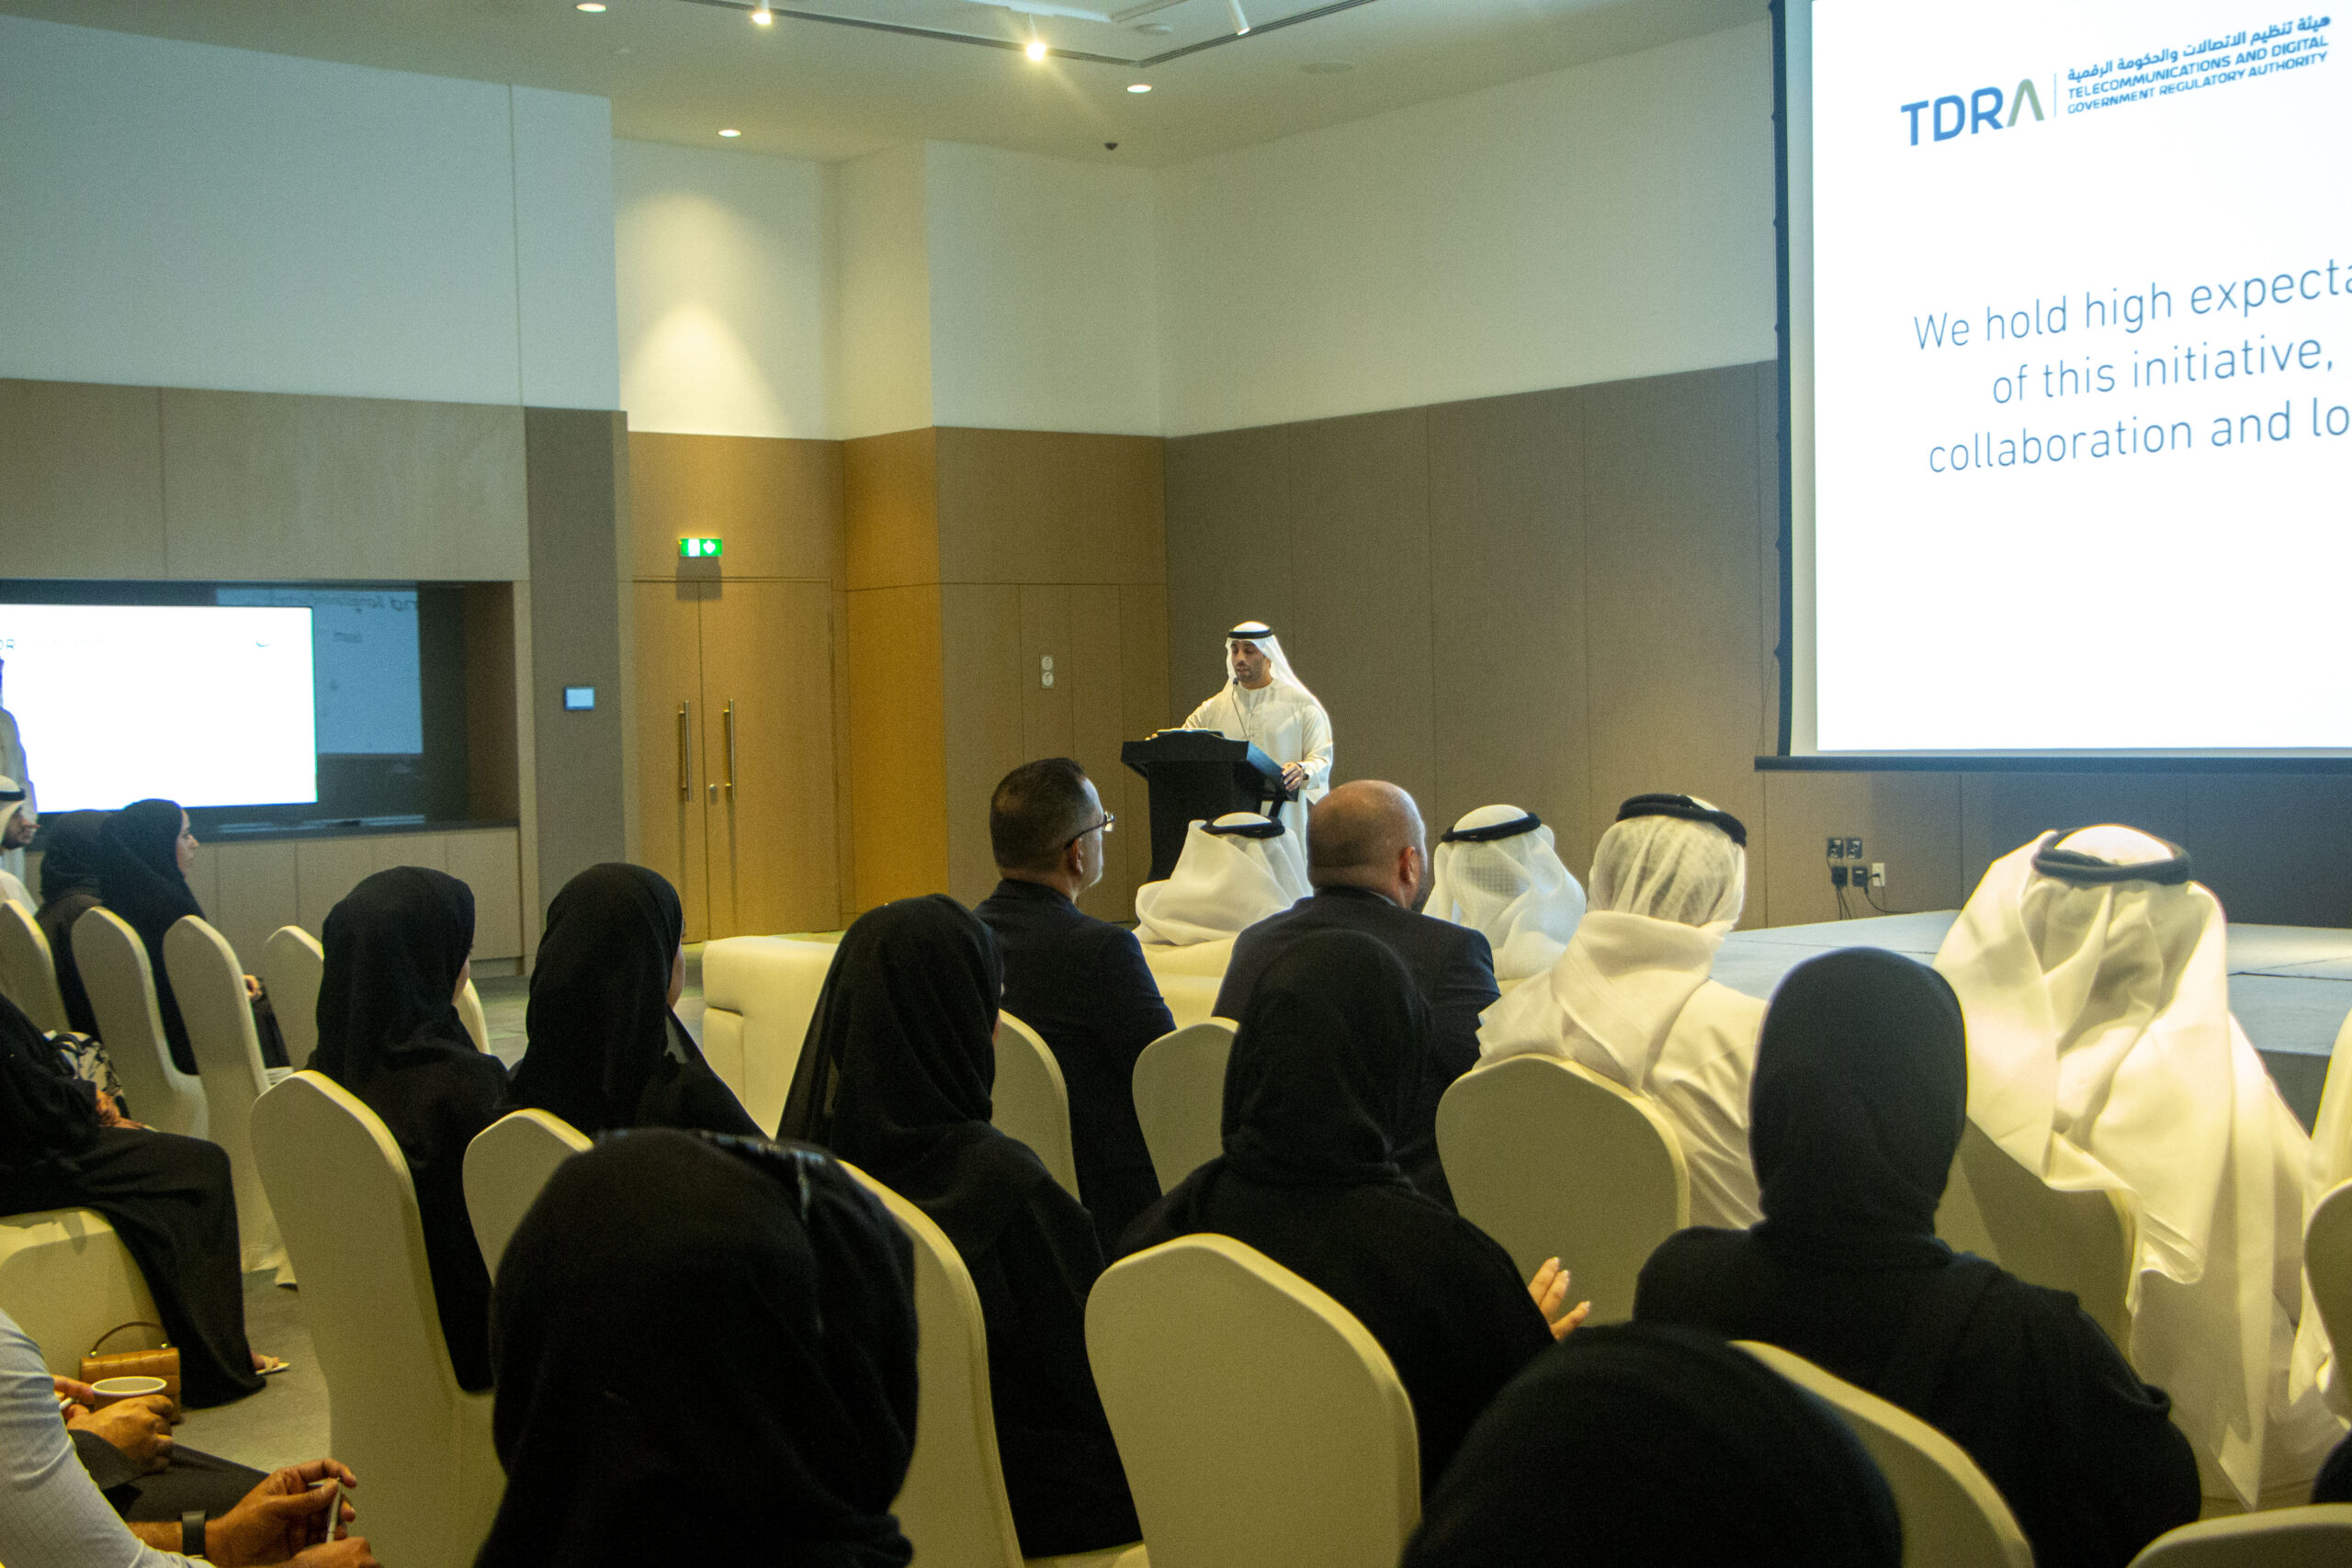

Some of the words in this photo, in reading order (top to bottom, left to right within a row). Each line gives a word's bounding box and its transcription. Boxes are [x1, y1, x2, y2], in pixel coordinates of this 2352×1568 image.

[2183, 30, 2246, 57] الاتصالات
[2250, 20, 2293, 47] تنظيم
[2297, 15, 2332, 33] هيئة
[2067, 55, 2232, 100] TELECOMMUNICATIONS
[2234, 47, 2267, 65] AND
[2271, 35, 2329, 57] DIGITAL
[2067, 60, 2113, 84] الرقمية
[2067, 87, 2155, 114] GOVERNMENT
[2159, 69, 2247, 96] REGULATORY
[2247, 51, 2327, 77] AUTHORITY
[2117, 48, 2178, 71] والحكومة
[1900, 78, 2045, 146] TDRA
[1914, 312, 1970, 350] We
[1986, 295, 2067, 341] hold
[2086, 282, 2172, 333] high
[1993, 364, 2029, 403] of
[2042, 356, 2116, 398] this
[2133, 333, 2334, 389] initiative,
[1929, 416, 2192, 472] collaboration
[2211, 400, 2291, 447] and
[2312, 396, 2350, 437] lo
